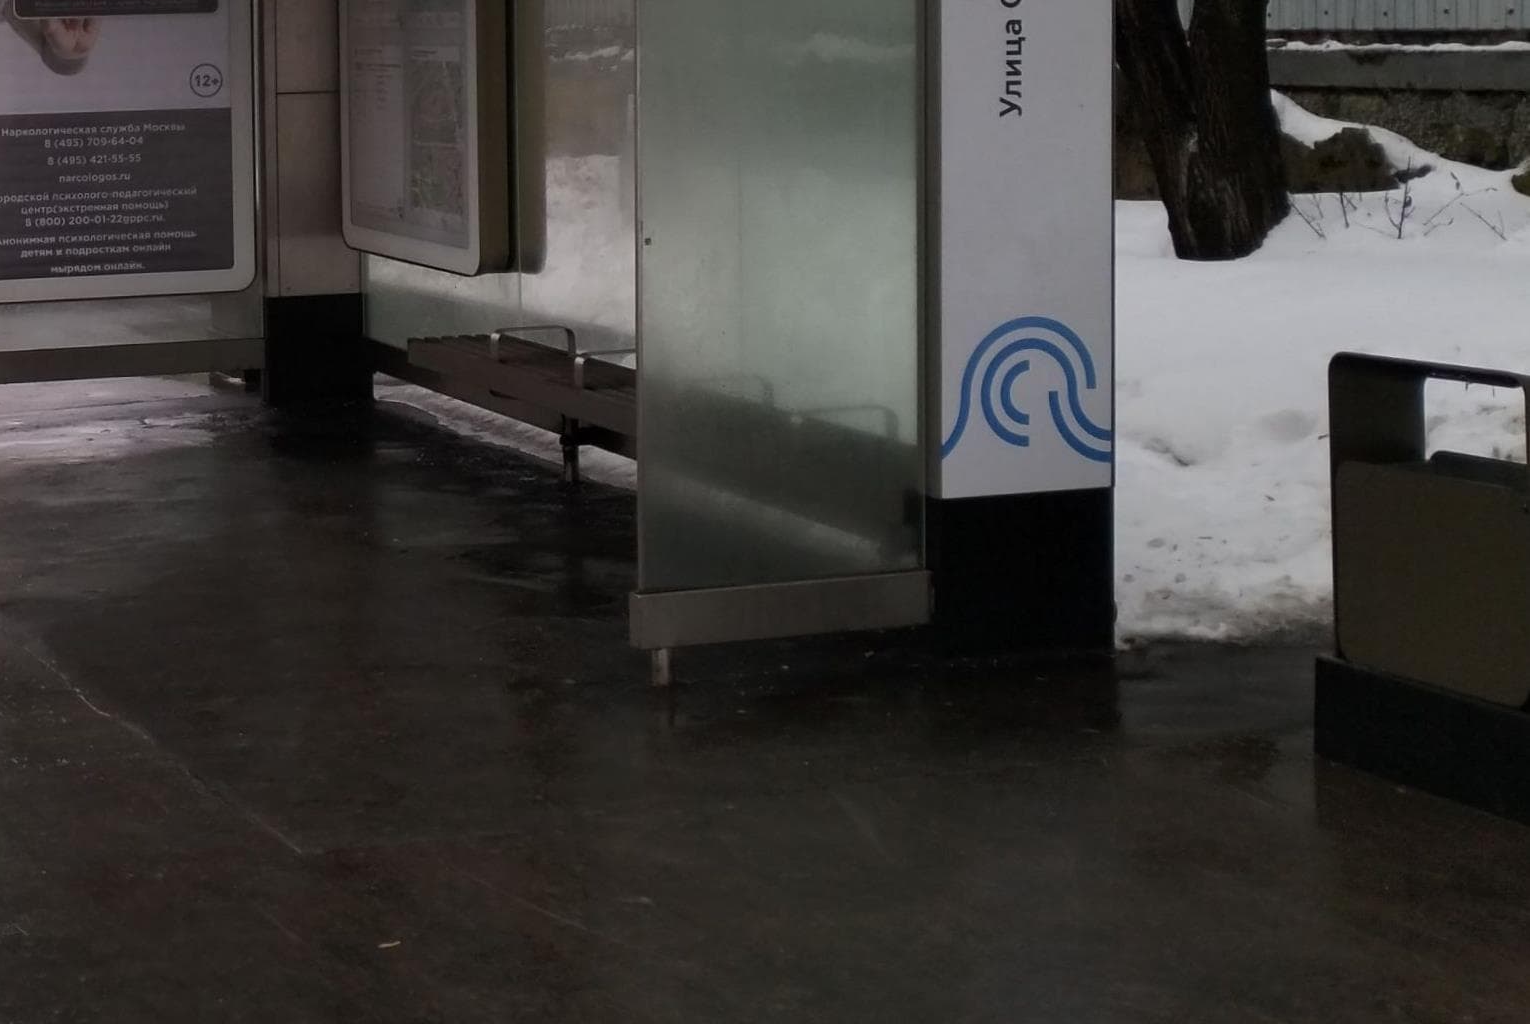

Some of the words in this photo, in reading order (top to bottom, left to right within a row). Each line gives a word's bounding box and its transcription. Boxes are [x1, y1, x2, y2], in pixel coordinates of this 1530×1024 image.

[999, 18, 1026, 117] Улица
[194, 74, 219, 87] 12+
[0, 125, 98, 138] Наркологическая
[100, 123, 141, 135] служба
[143, 122, 186, 133] Москвы
[44, 139, 52, 149] 8
[87, 136, 144, 147] 709-64-04
[47, 156, 54, 166] 8
[57, 155, 86, 166] (495)
[89, 153, 142, 164] 421-55-55
[58, 172, 131, 185] narcologos.ru
[121, 200, 169, 212] помощь)
[35, 217, 66, 228] (800)
[58, 232, 152, 245] психологическая
[153, 229, 197, 241] помощь
[20, 248, 53, 259] детям
[56, 248, 63, 256] и
[65, 245, 130, 257] подросткам
[132, 242, 173, 253] онлайн
